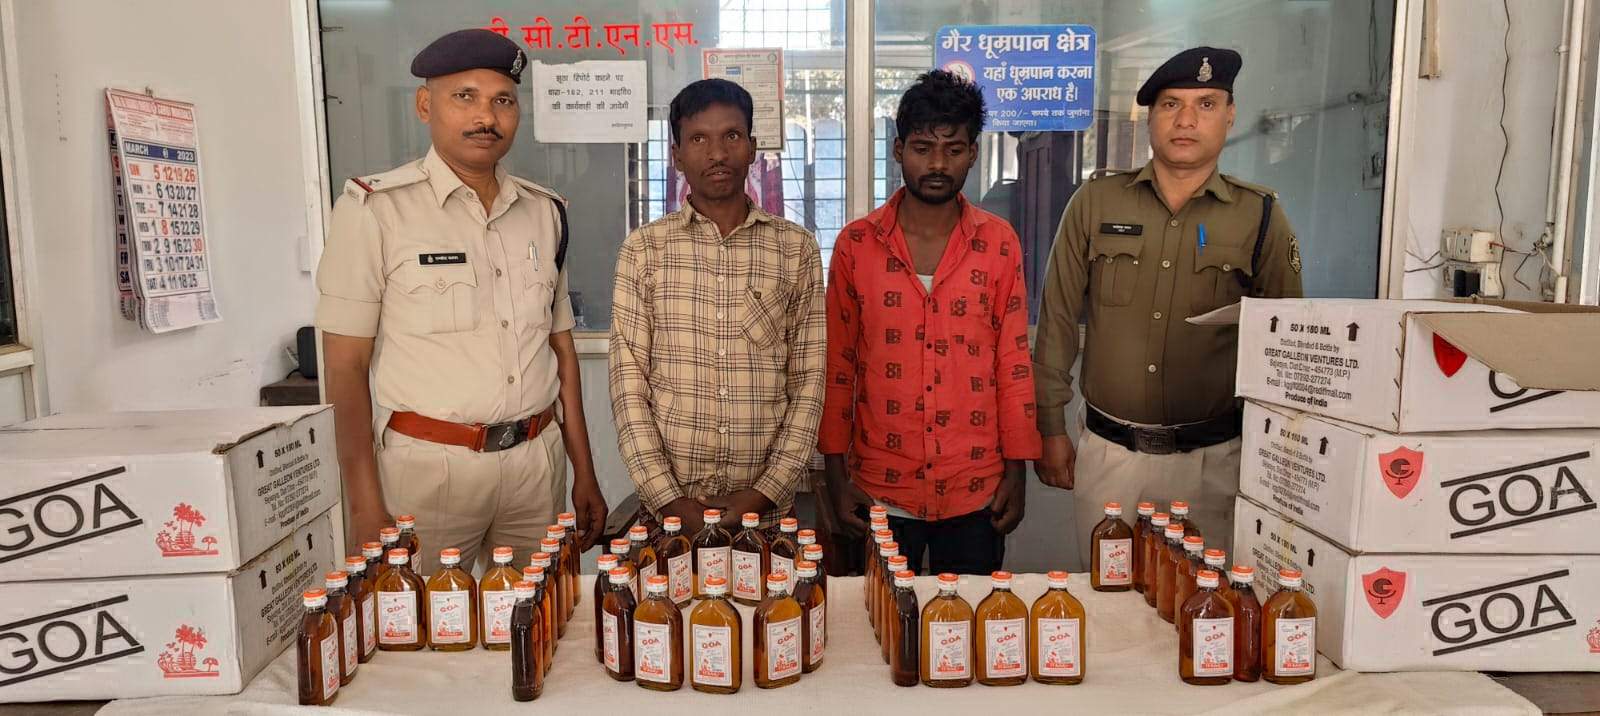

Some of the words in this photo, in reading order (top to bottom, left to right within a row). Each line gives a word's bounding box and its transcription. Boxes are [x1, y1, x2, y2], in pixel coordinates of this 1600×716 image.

[941, 28, 973, 53] गैर
[978, 34, 1050, 59] धूम्रपान
[1056, 27, 1091, 53] क्षेत्र
[1010, 65, 1054, 85] धूम्रपान
[1057, 66, 1093, 79] करना
[996, 87, 1017, 103] एक
[1021, 86, 1062, 100] अपराध
[126, 142, 149, 157] MARCH
[176, 150, 194, 161] 2023
[153, 164, 160, 180] 5
[163, 166, 174, 181] 12
[174, 167, 183, 182] 19
[184, 168, 196, 183] 26
[156, 182, 163, 199] 6
[165, 184, 175, 200] 13
[176, 186, 186, 200] 20
[186, 187, 196, 201] 27
[158, 200, 164, 217] 7
[168, 203, 178, 217] 14
[178, 204, 187, 218] 21
[188, 204, 199, 218] 28
[151, 218, 158, 236] 1
[161, 219, 168, 235] 8
[170, 220, 180, 235] 15
[180, 221, 190, 235] 22
[190, 221, 200, 235] 29
[153, 238, 160, 254] 2
[163, 238, 171, 253] 9
[173, 238, 183, 253] 16
[183, 238, 191, 253] 23
[192, 238, 202, 252] 30
[156, 256, 163, 272] 3
[164, 256, 175, 271] 10
[175, 256, 184, 271] 17
[185, 256, 194, 270] 24
[194, 256, 204, 269] 31
[160, 275, 167, 289] 4
[167, 275, 177, 289] 11
[177, 274, 187, 288] 18
[188, 273, 198, 287] 25
[1290, 323, 1298, 332] 50
[1320, 326, 1331, 336] ML
[1264, 347, 1281, 358] GREAT
[1282, 350, 1308, 362] GALLEON
[1309, 354, 1343, 367] VENTURES
[1345, 358, 1359, 369] LTD.
[1285, 391, 1306, 403] Produce
[1306, 396, 1312, 405] of
[1313, 397, 1327, 407] India
[1449, 465, 1593, 527] GOA
[0, 483, 138, 551] GOA
[1430, 584, 1573, 644] GOA
[0, 610, 140, 674] GOA
[642, 638, 660, 646] GOA
[702, 640, 722, 649] GOA
[941, 635, 961, 646] GOA
[997, 632, 1017, 643] GOA
